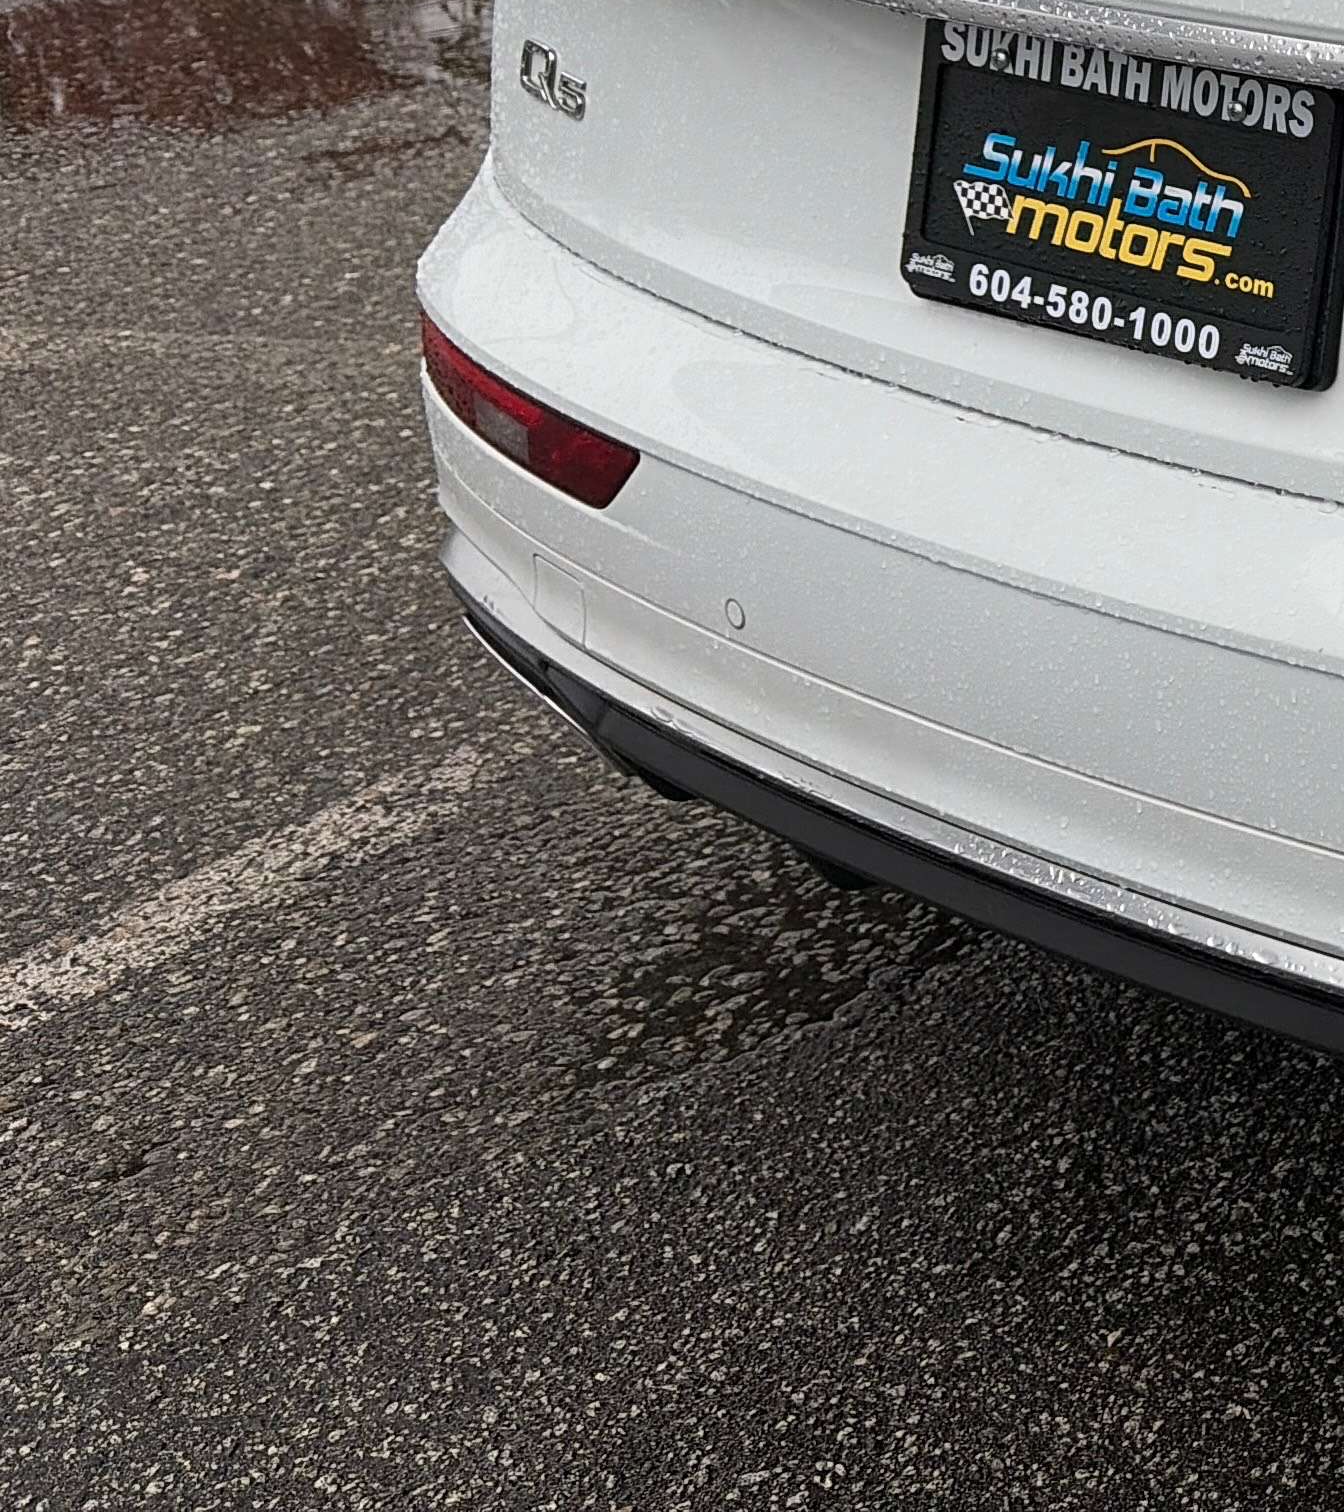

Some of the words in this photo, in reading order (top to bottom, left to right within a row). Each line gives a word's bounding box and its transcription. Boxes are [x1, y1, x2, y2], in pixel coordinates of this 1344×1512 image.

[520, 39, 587, 121] Q5
[939, 21, 1056, 83] SUKHI
[1060, 42, 1152, 104] BATH
[1160, 64, 1316, 138] MOTORS
[963, 133, 1117, 207] Sukhi
[1124, 166, 1244, 238] Bath
[968, 263, 1220, 360] 604-580-1000
